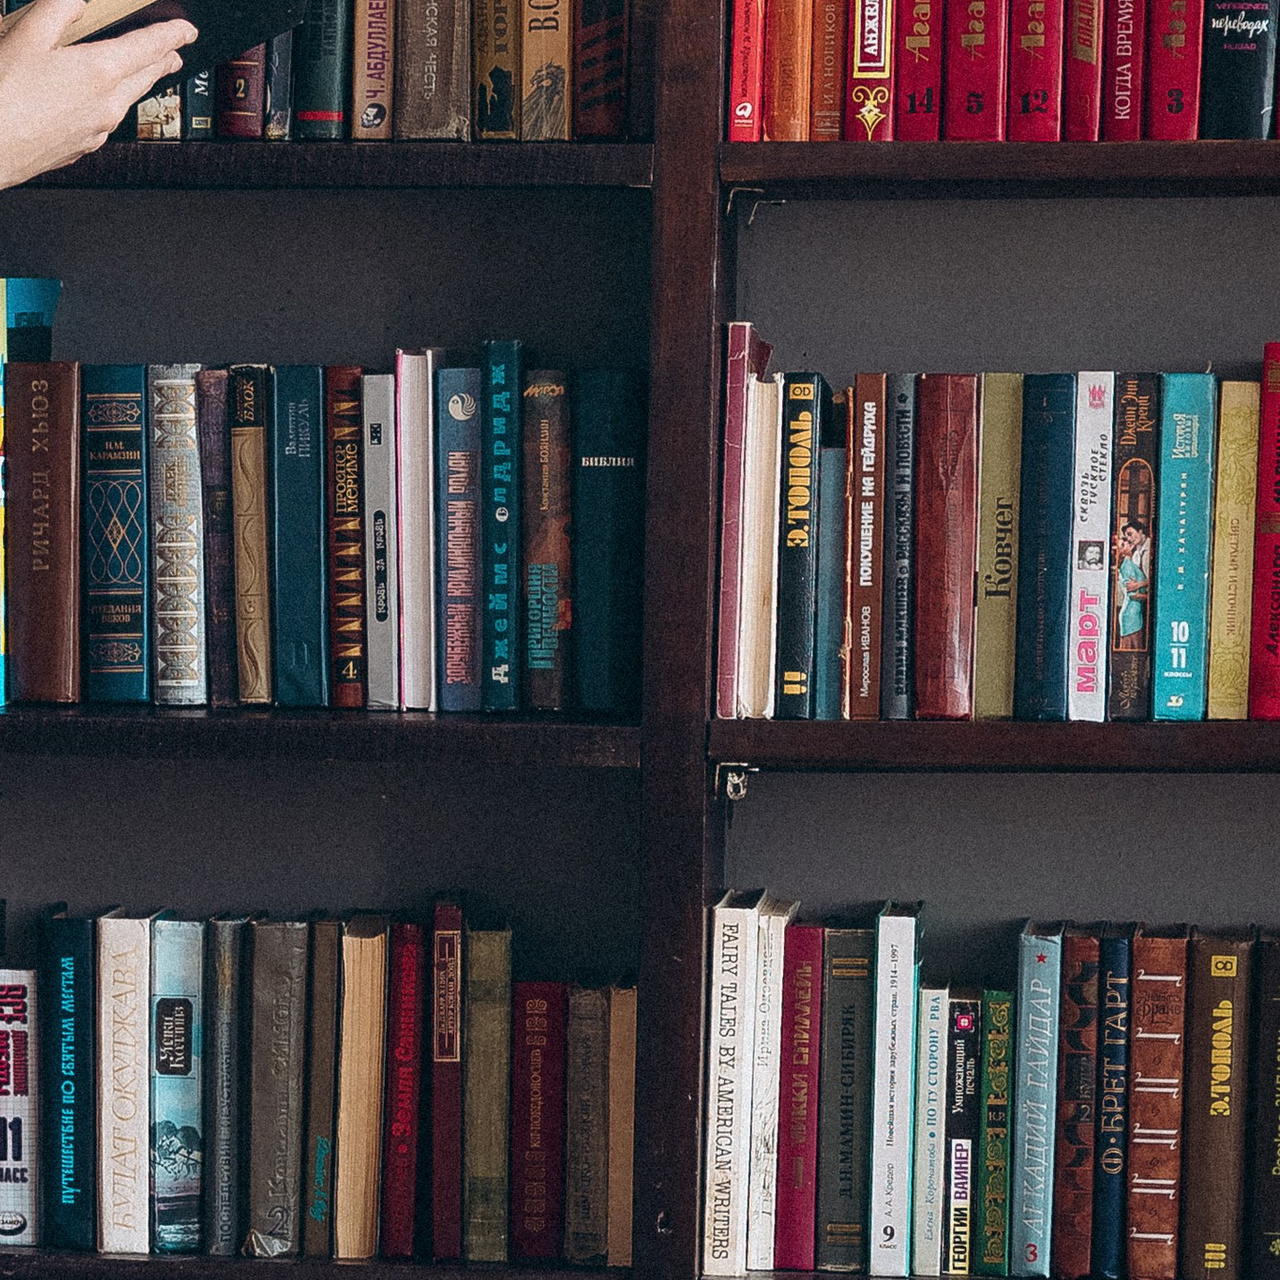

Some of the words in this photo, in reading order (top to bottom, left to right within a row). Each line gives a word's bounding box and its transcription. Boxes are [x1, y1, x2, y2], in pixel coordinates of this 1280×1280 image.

[366, 85, 386, 99] Ч.
[1114, 62, 1133, 120] КОГДА
[31, 378, 49, 451] ХЬЮЗ
[243, 380, 255, 422] БЛОК
[299, 398, 311, 458] ПИКУЛЬ
[538, 419, 550, 463] БОЯНДИН
[859, 402, 877, 473] ГЕЙДРИХА
[1098, 433, 1108, 482] СТЕКЛО
[860, 476, 875, 497] НА
[1080, 472, 1090, 523] СКВОЗЬ
[1089, 448, 1099, 506] ТУСКЛОЕ
[31, 470, 51, 571] РИЧАРД
[447, 500, 474, 597] КРИМИНАЛЬНЫЙ
[858, 501, 875, 586] ПОКУШЕНИЕ
[984, 497, 1014, 600] Ковчег
[446, 603, 474, 685] ЗАРУБЕЖНЫЙ
[860, 605, 872, 651] ИВАНОВ
[1074, 588, 1100, 694] март
[859, 652, 871, 697] Мирослав
[721, 922, 740, 965] FAIRY
[110, 944, 139, 1122] ОКУДЖАВА
[720, 982, 738, 1037] TALES
[928, 996, 940, 1021] РВА
[1029, 977, 1054, 1089] ГАЙДАР
[1104, 970, 1129, 1045] ГАРТ
[719, 1045, 737, 1069] BY
[926, 1027, 939, 1086] СТОРОНУ
[951, 1039, 965, 1114] Умножающий
[964, 1058, 976, 1095] печаль
[715, 1075, 735, 1172] AMERICAN
[926, 1089, 937, 1105] ТУ
[926, 1108, 937, 1127] ПО
[1101, 1057, 1126, 1133] БРЕТ
[111, 1127, 138, 1231] БУЛАТ
[1021, 1099, 1048, 1237] АРКАДИЙ
[711, 1179, 731, 1260] WRITERS
